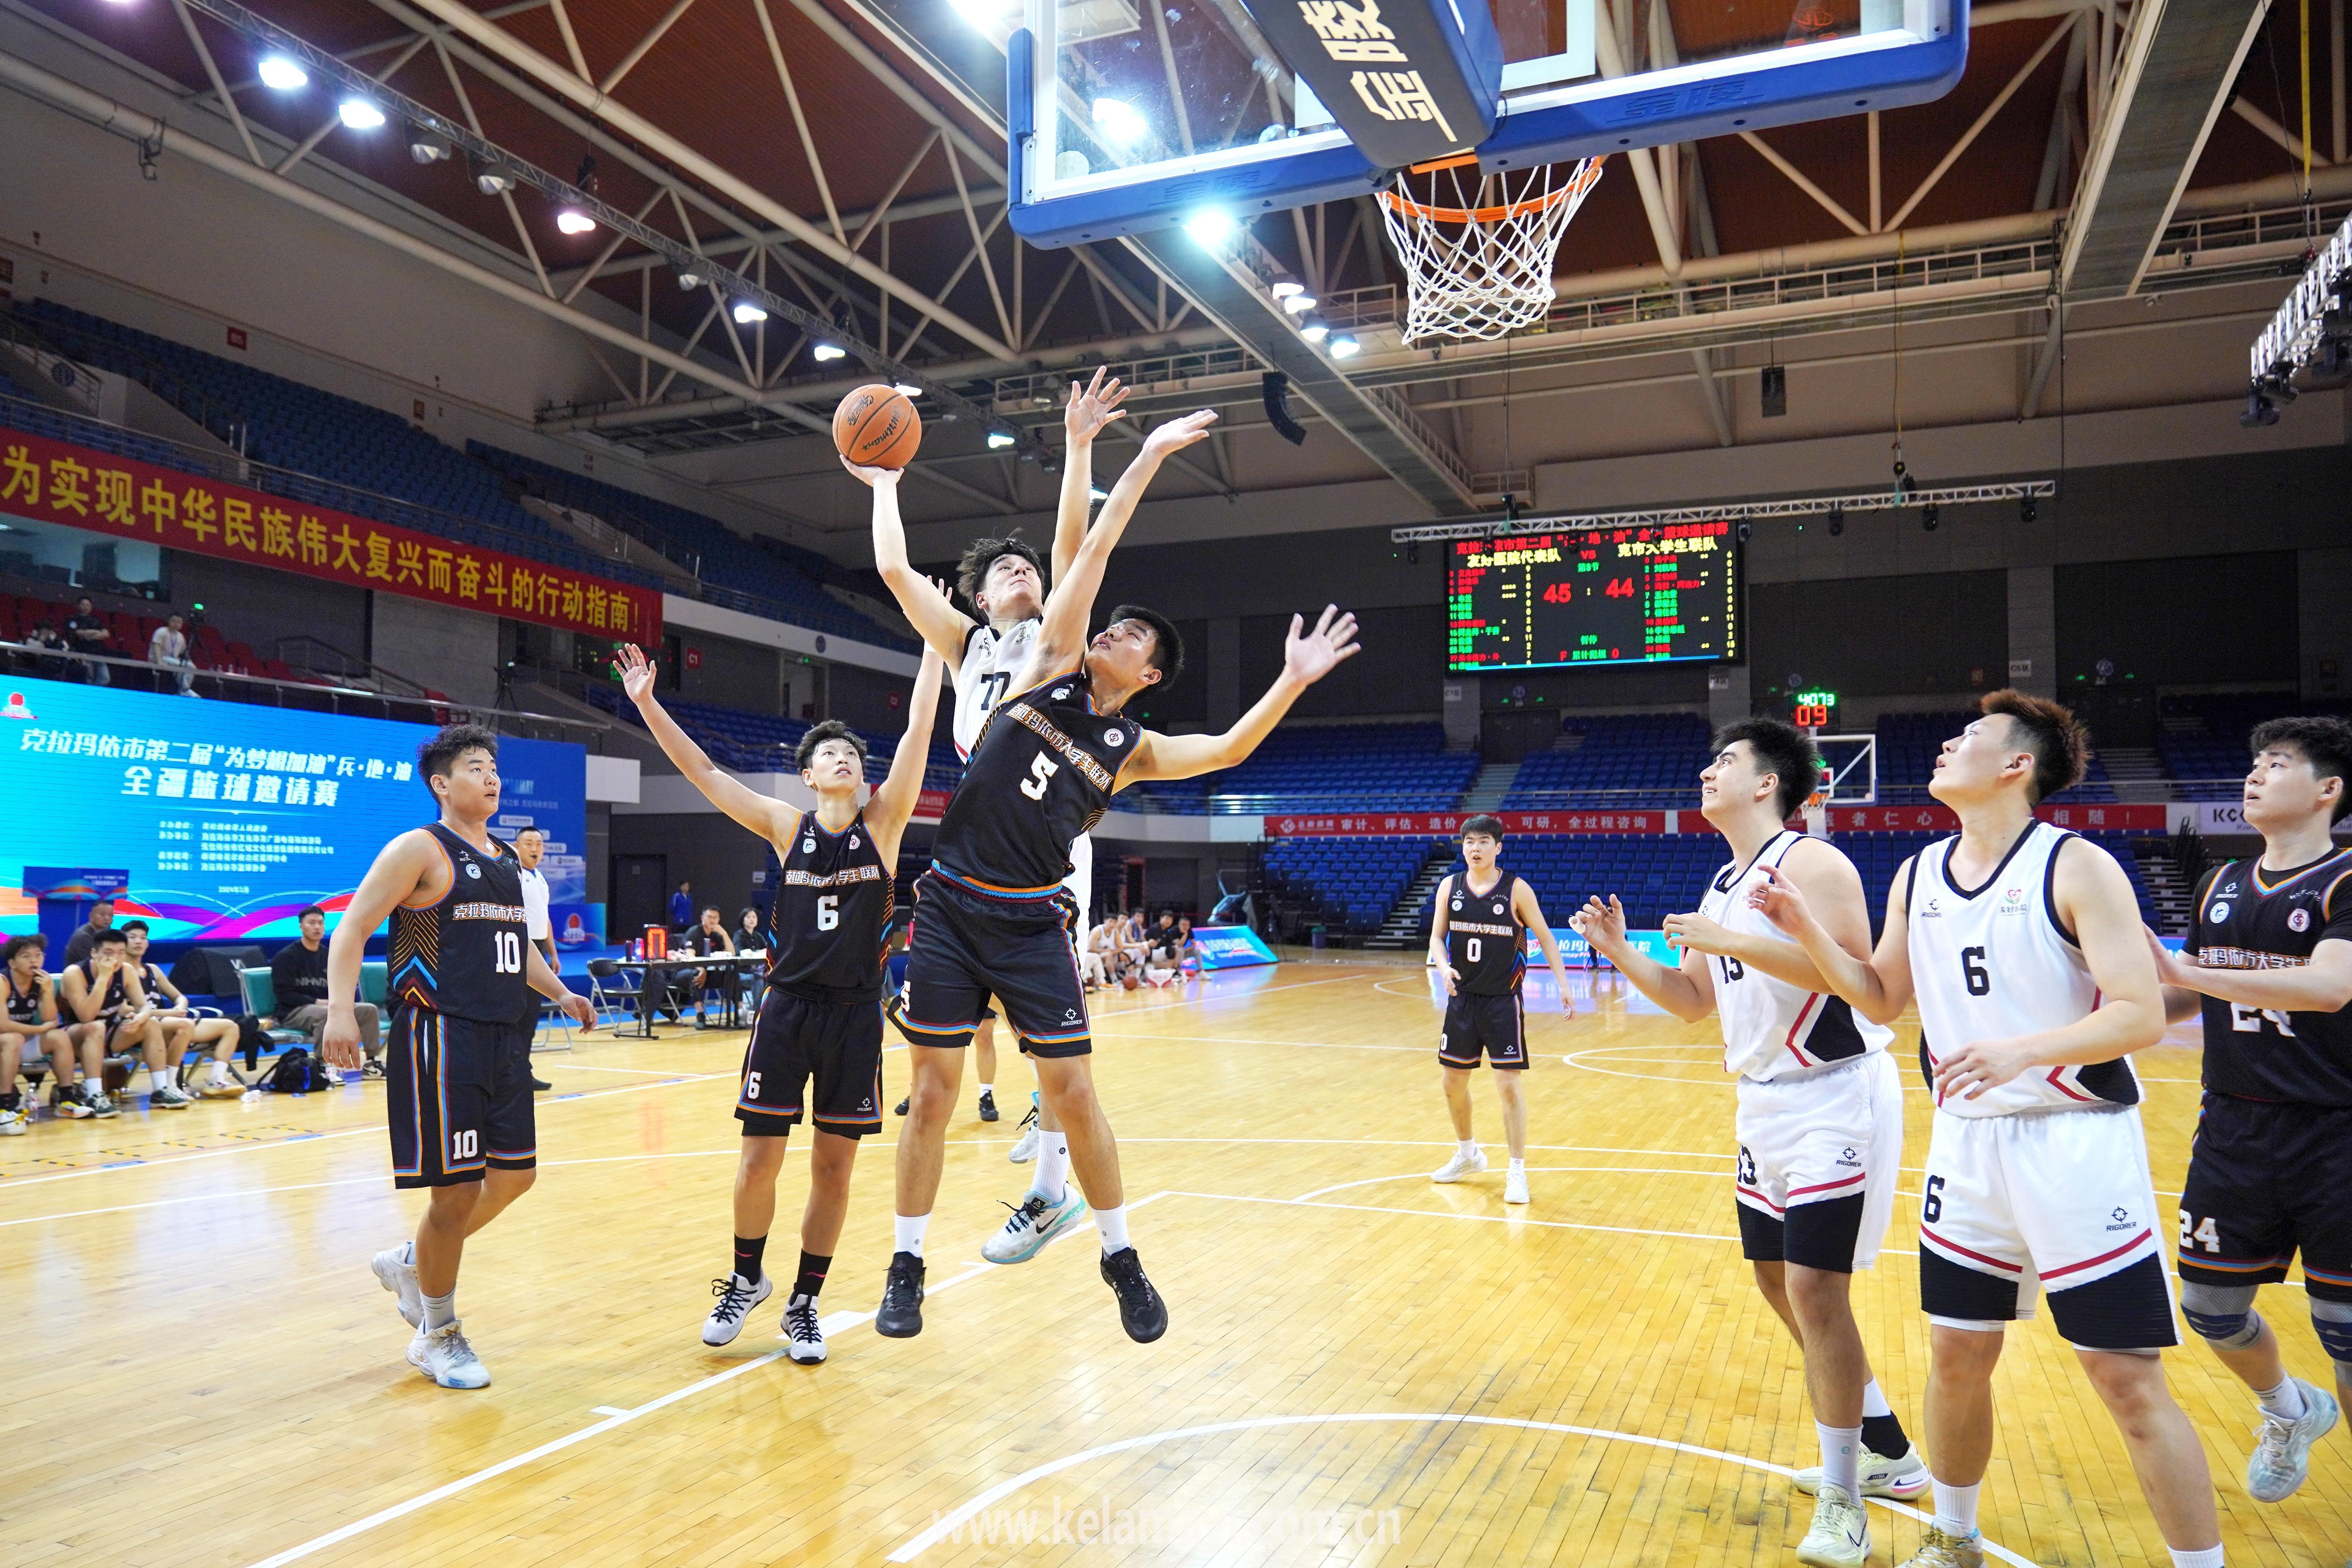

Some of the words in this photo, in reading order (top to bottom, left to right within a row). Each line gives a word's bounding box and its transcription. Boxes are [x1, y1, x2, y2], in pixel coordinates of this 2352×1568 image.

[2, 445, 639, 633] 为实现中华民族伟大复兴而奋斗的行动指南！
[1467, 547, 1561, 568] 友好医院代表队
[1543, 583, 1572, 604] 45
[1606, 577, 1634, 598] 44
[1611, 648, 1619, 659] 0
[1796, 704, 1827, 726] 09
[120, 765, 339, 807] 全疆篮球邀请赛
[1020, 750, 1060, 801] 5
[817, 895, 839, 931] 6
[495, 931, 521, 974] 10
[1467, 938, 1482, 962] 0
[1961, 946, 1990, 996] 6
[748, 1071, 761, 1099] 6
[453, 1129, 478, 1160] 10
[1836, 1159, 1862, 1168] RIGORER
[1924, 1175, 1945, 1223] 6
[2106, 1221, 2137, 1232] RIGORER
[2179, 1208, 2220, 1253] 24
